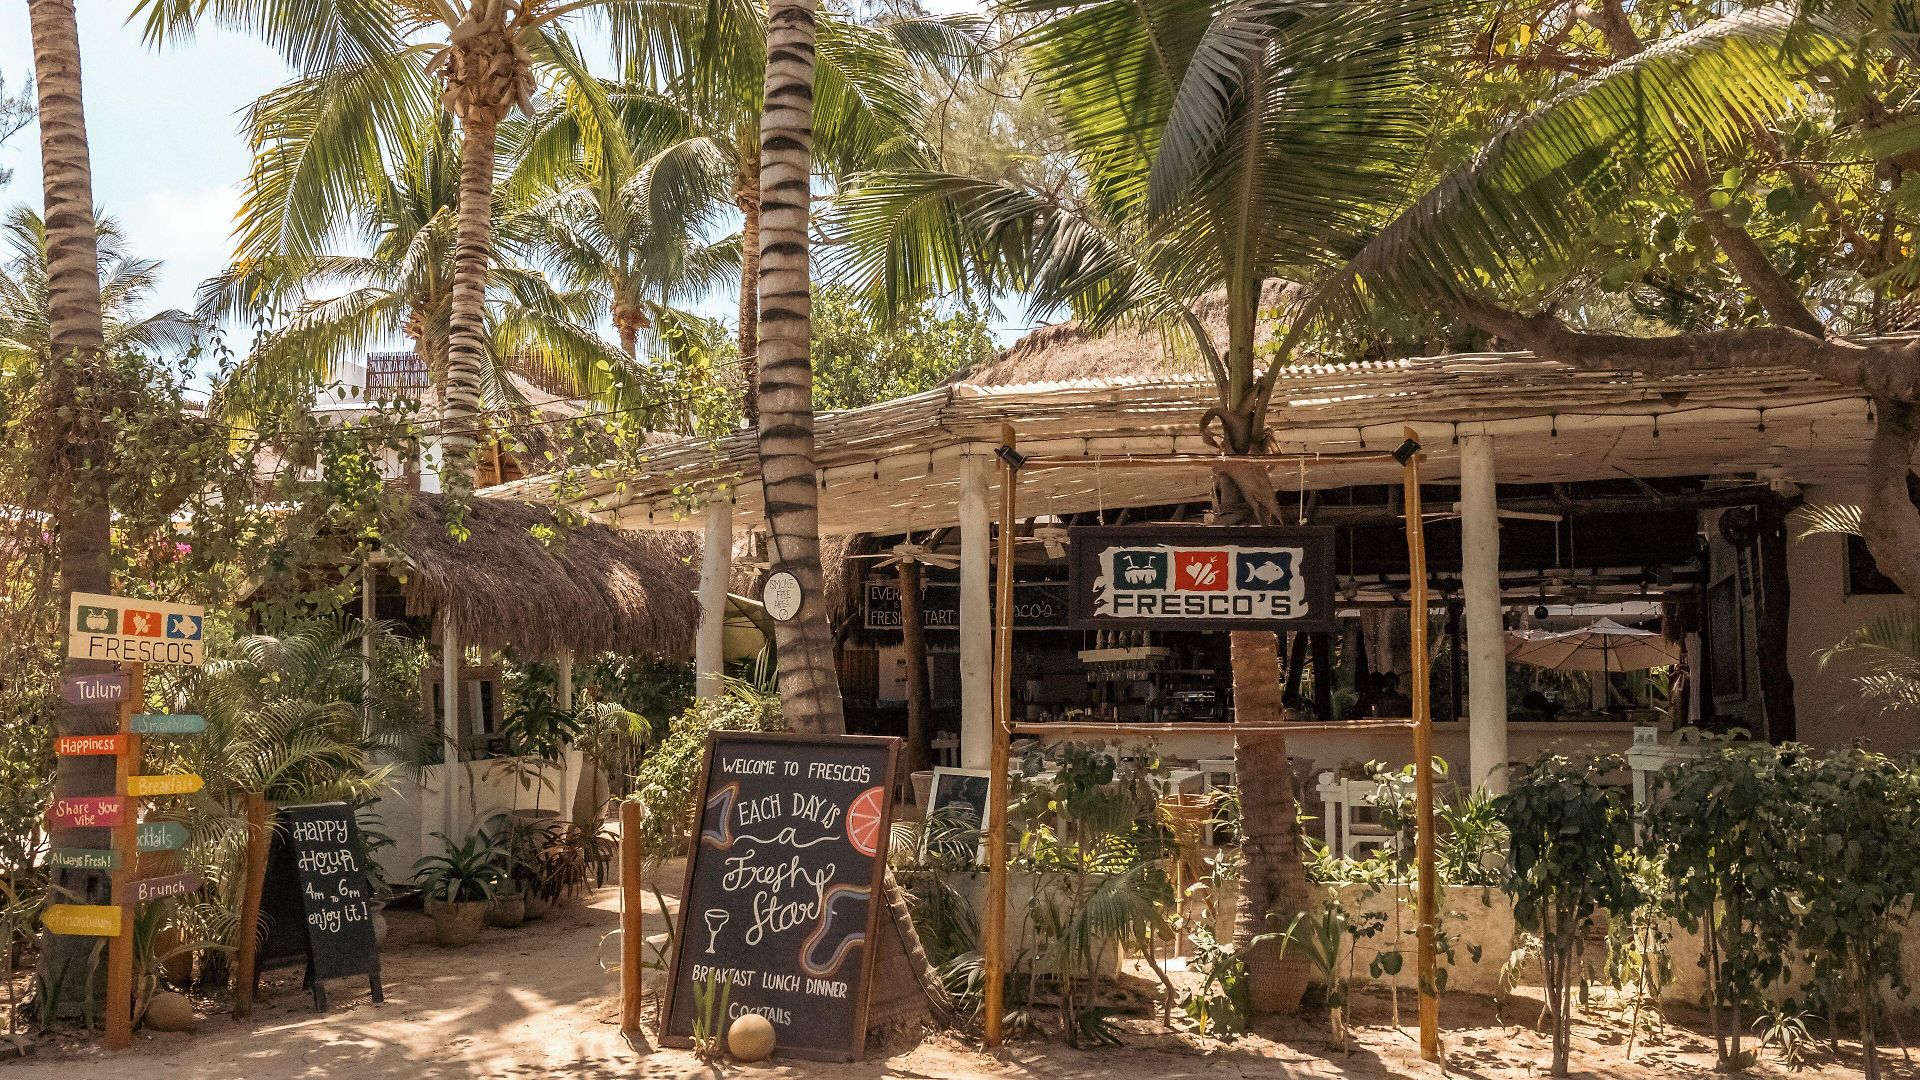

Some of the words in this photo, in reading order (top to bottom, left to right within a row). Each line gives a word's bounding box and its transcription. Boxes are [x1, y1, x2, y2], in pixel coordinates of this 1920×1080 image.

[1113, 594, 1291, 615] FRESCO'S
[89, 636, 194, 664] FRESCO'S
[76, 681, 122, 700] Tulum
[60, 738, 115, 754] Happiness
[722, 757, 777, 776] WELCOME
[783, 761, 799, 776] TO
[808, 762, 871, 784] FRESCO'S
[138, 779, 194, 793] Breakfast
[56, 800, 90, 817] Share
[737, 793, 782, 826] EACH
[791, 793, 827, 823] DAY
[821, 803, 841, 829] IS
[50, 852, 83, 868] Always
[84, 854, 111, 868] Fresh!
[722, 849, 834, 893] Fresh
[138, 881, 185, 900] Brunch
[308, 908, 341, 932] enjoy
[762, 971, 800, 992] LUNCH
[805, 978, 848, 999] DINNER
